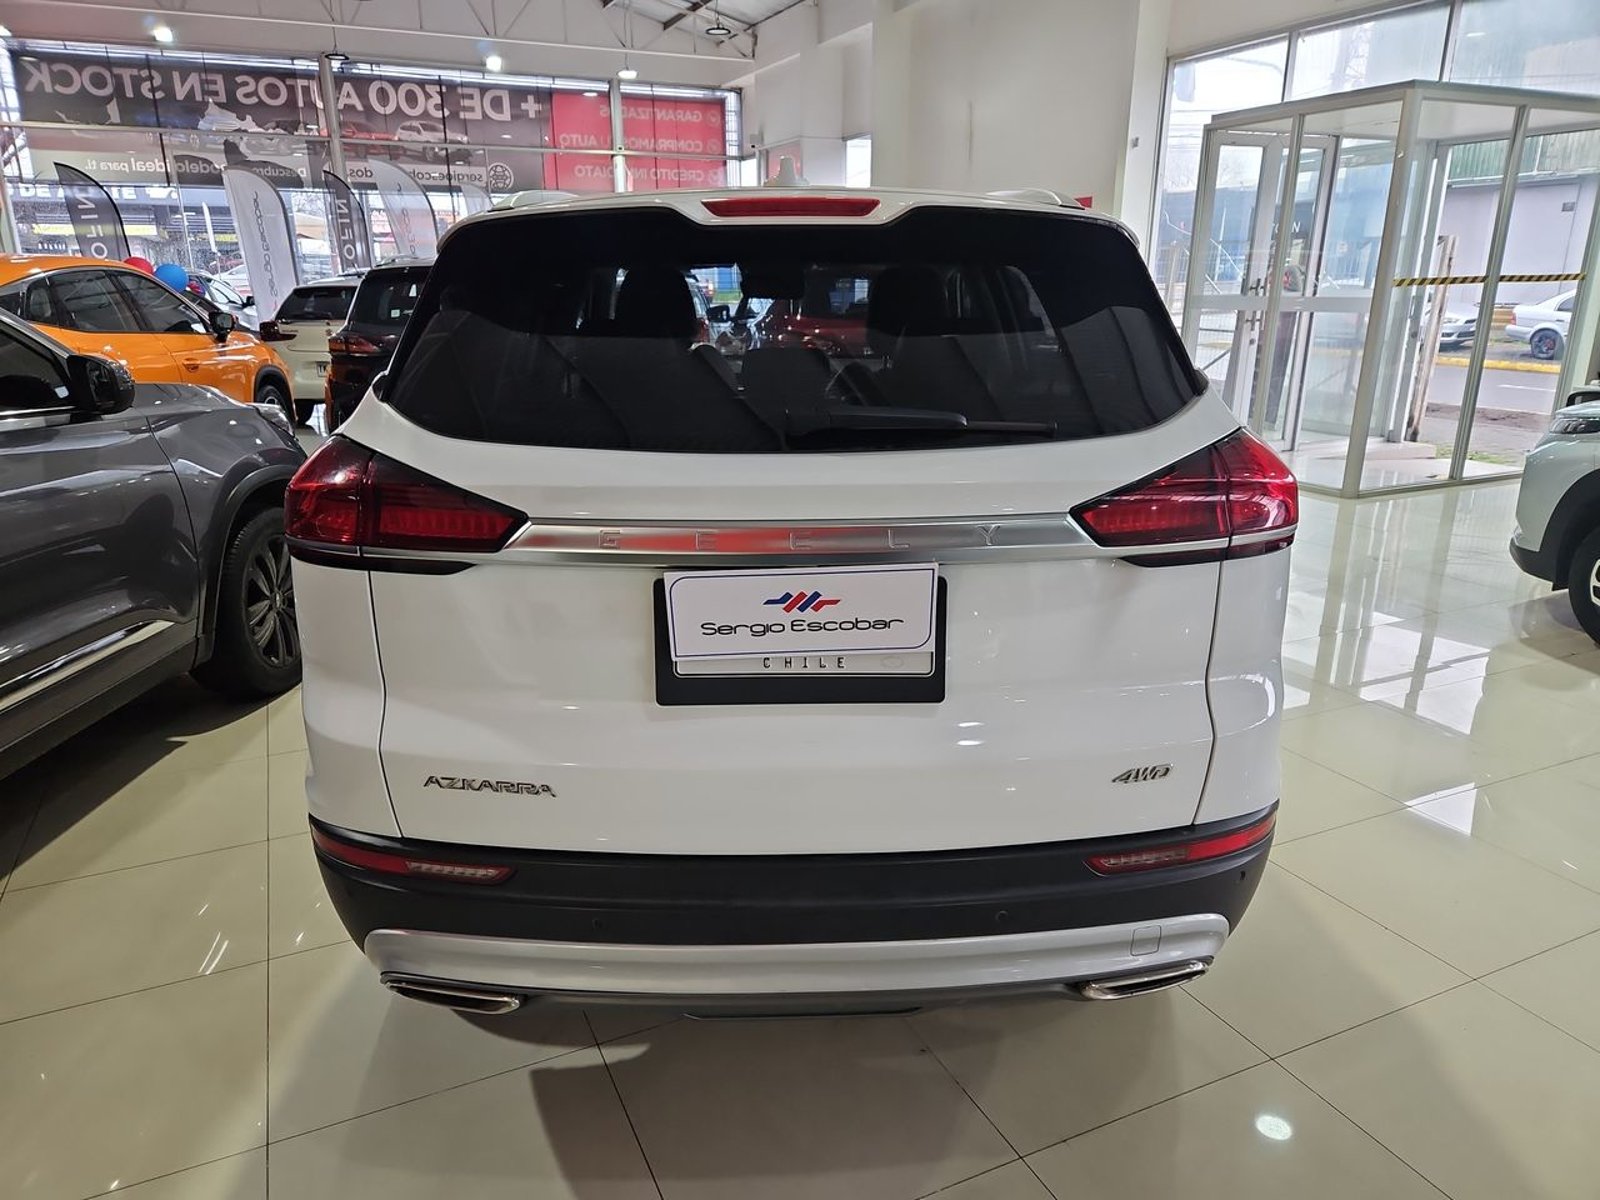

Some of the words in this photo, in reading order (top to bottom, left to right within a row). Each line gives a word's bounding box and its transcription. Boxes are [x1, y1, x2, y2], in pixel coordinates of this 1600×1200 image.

[599, 523, 1000, 551] GEELY
[700, 620, 786, 638] Sergio
[790, 618, 904, 633] Escobar
[762, 655, 847, 670] CHILE
[1111, 763, 1172, 784] 4WD
[423, 775, 557, 798] AZKARRA
